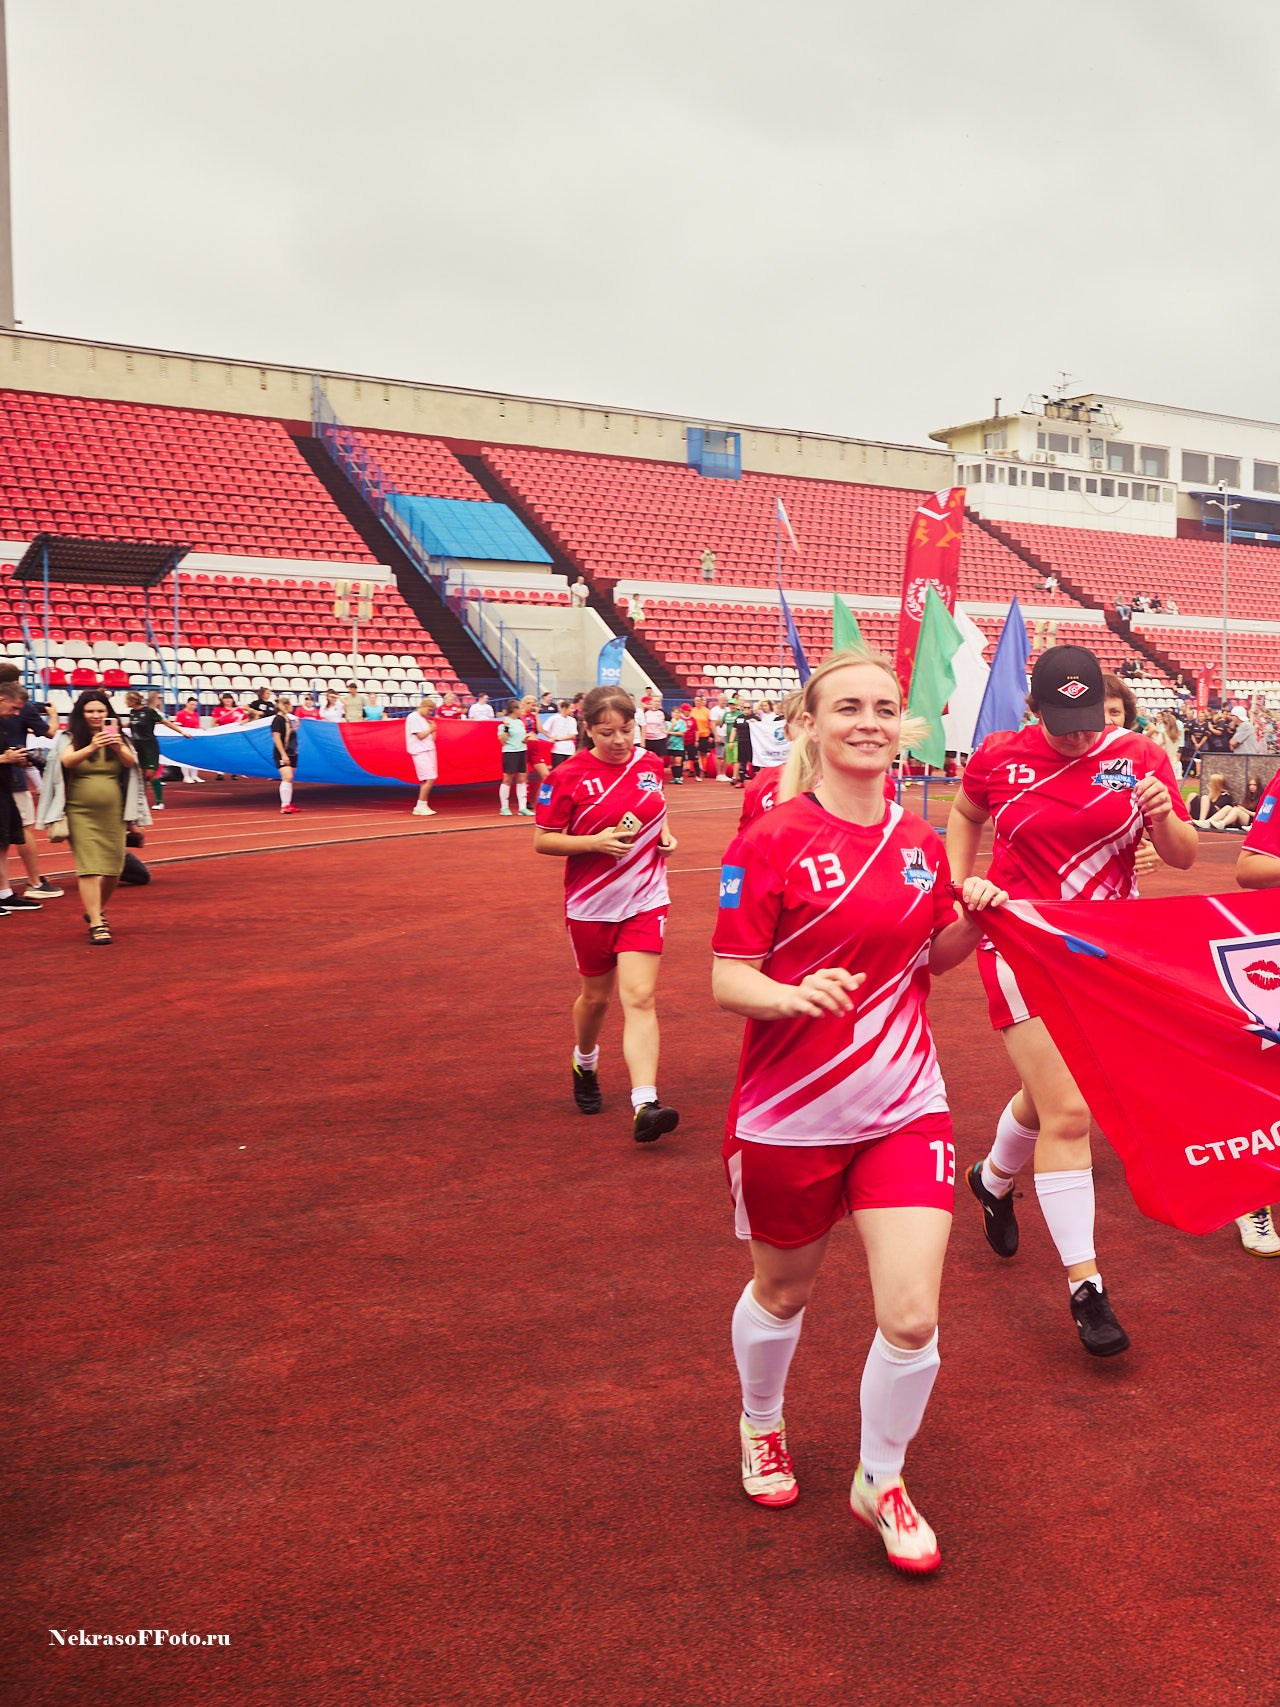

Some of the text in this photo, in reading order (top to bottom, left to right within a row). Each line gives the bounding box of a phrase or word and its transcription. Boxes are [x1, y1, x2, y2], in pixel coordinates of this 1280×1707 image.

[582, 777, 605, 796] 11
[1006, 763, 1036, 784] 15
[799, 852, 846, 893] 13
[929, 1139, 956, 1187] 13
